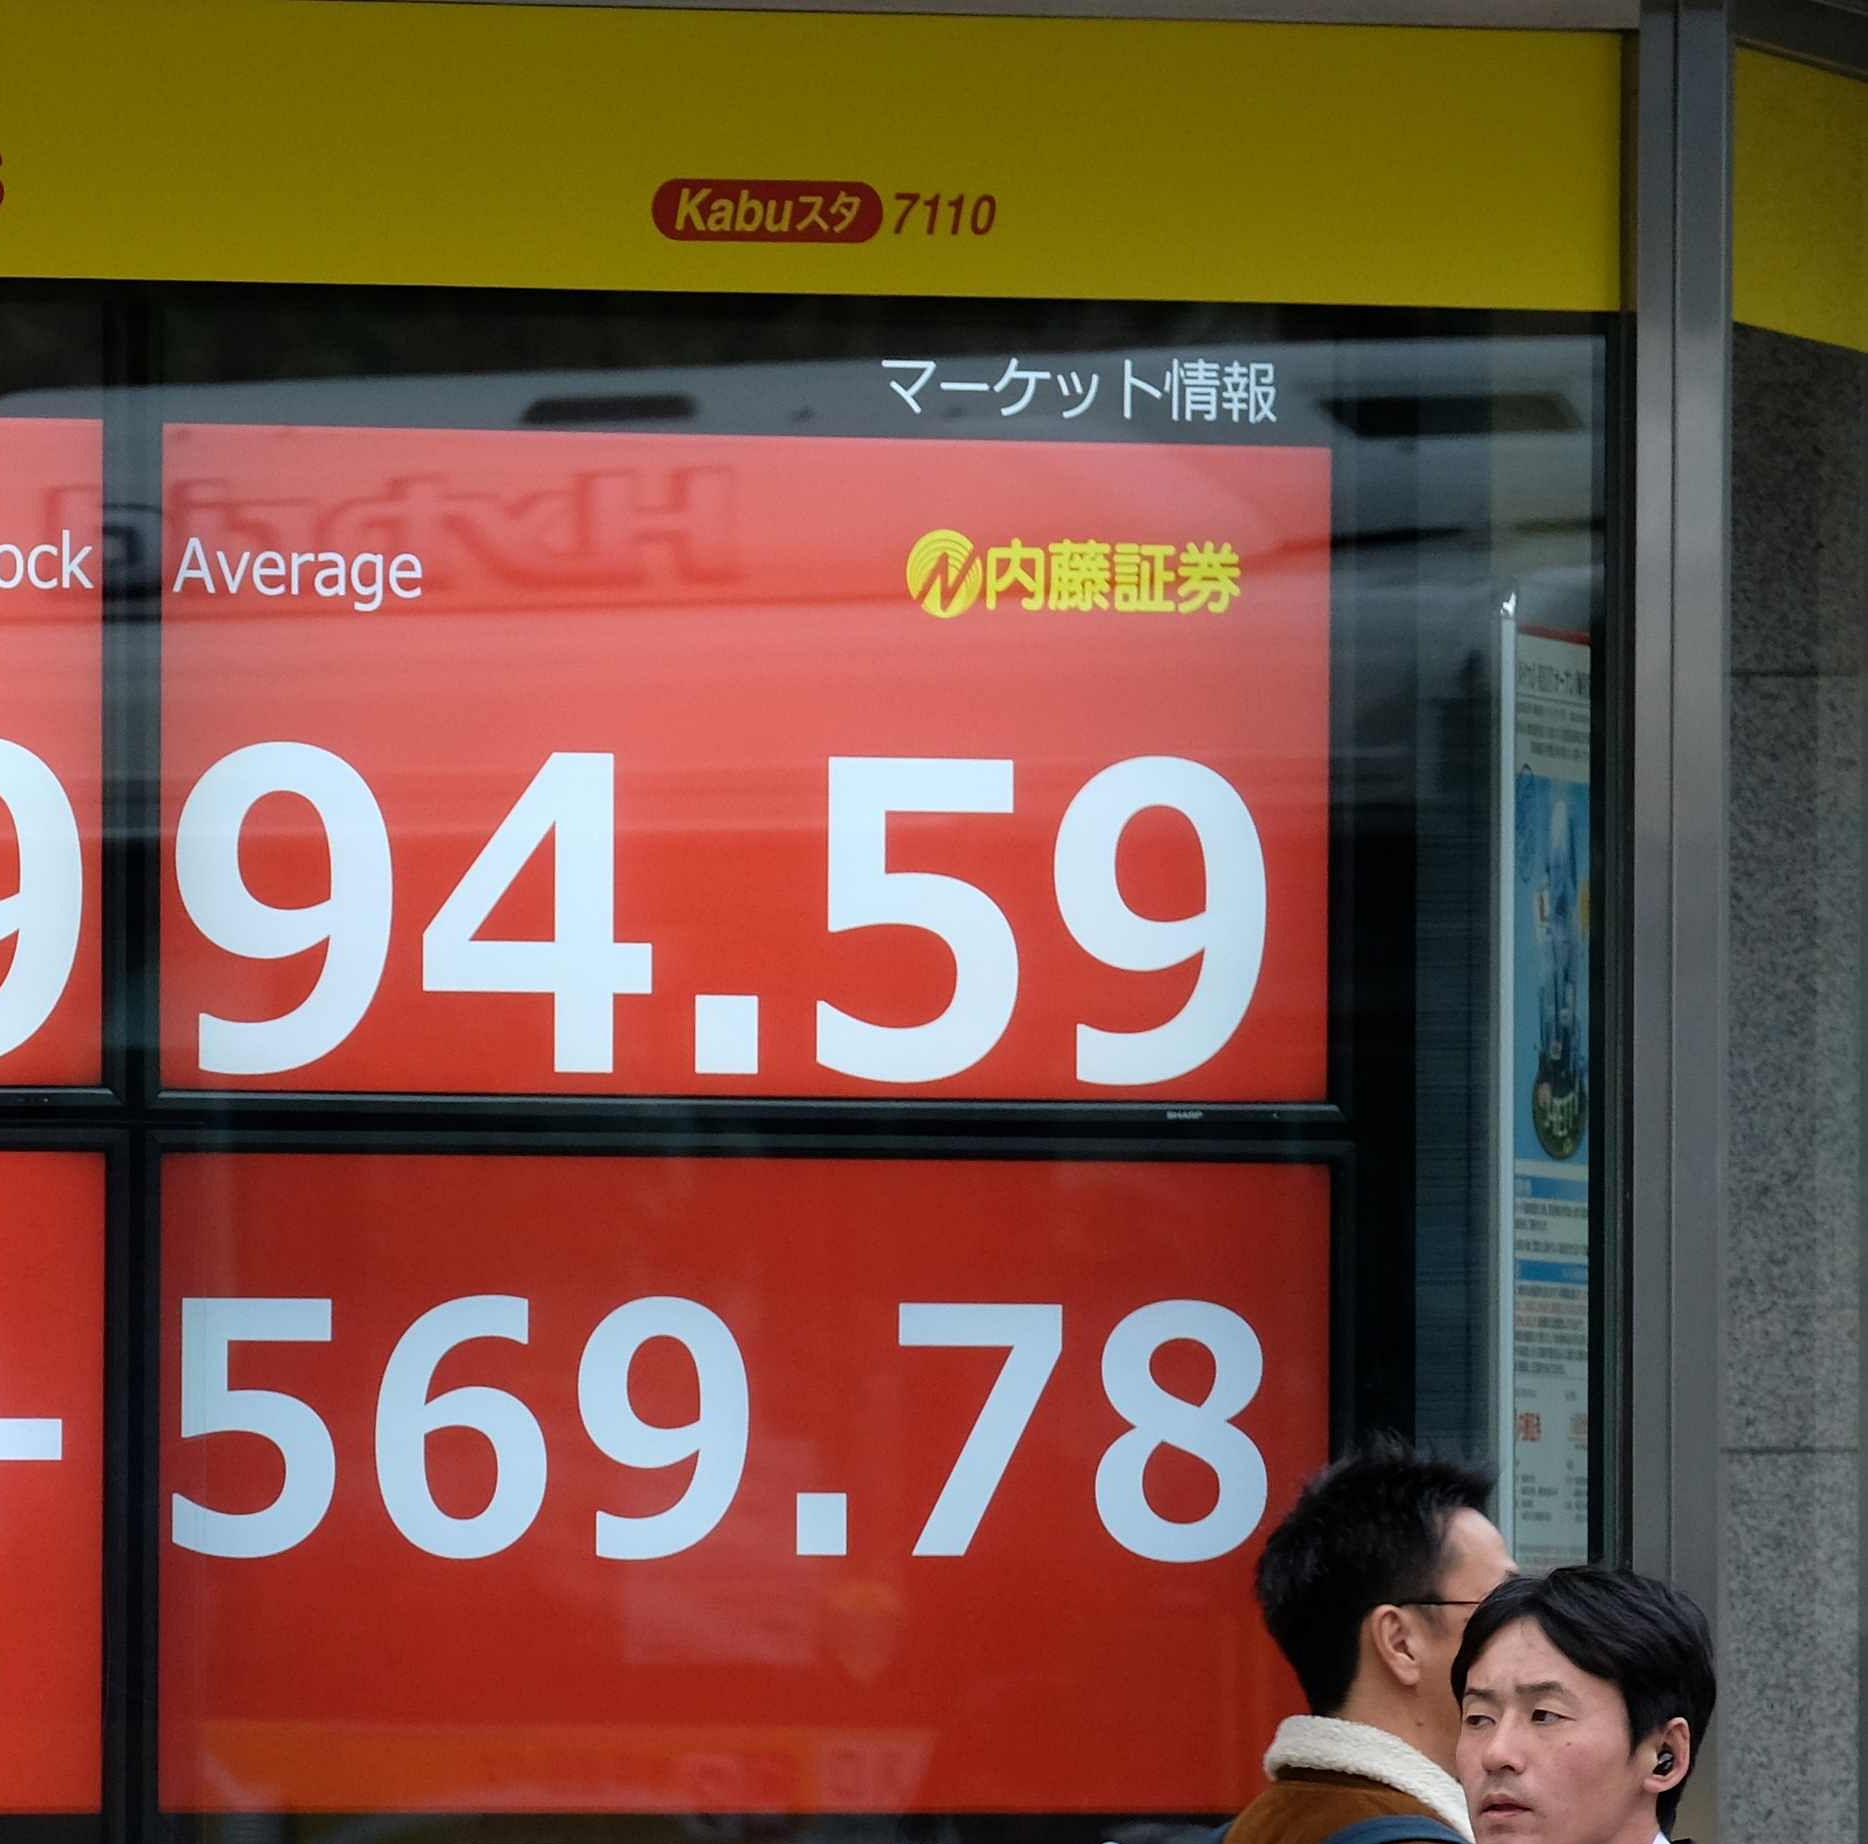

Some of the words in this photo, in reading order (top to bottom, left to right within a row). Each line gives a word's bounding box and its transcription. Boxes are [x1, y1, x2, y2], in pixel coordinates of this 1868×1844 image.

[675, 189, 861, 233] Kabuスタ
[894, 193, 996, 235] 7110
[882, 358, 1276, 423] マーケット情報
[174, 537, 422, 611] Average
[986, 538, 1240, 614] 内藤証券
